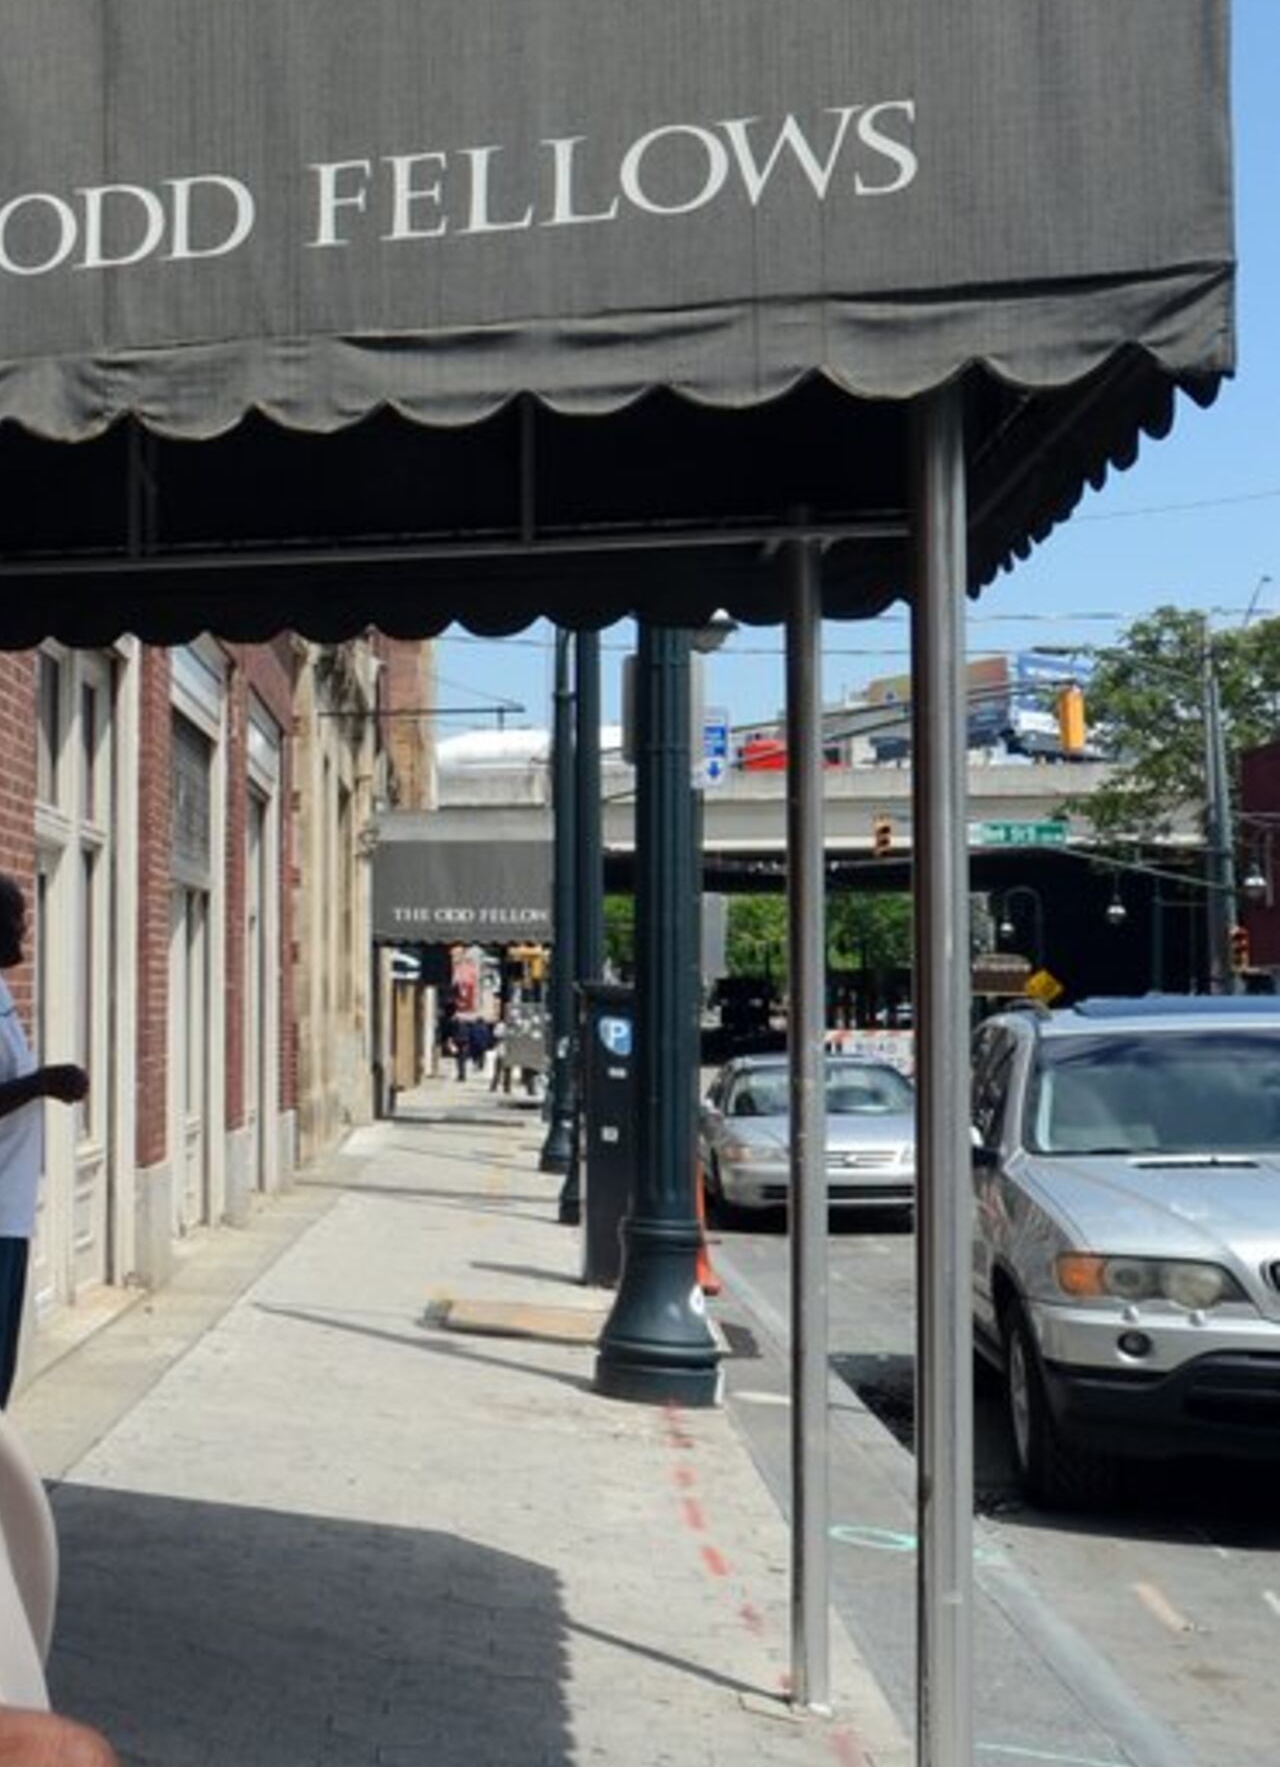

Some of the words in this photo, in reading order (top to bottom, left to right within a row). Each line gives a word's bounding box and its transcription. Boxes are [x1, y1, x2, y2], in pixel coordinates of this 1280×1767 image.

[305, 100, 919, 247] FELLOWS
[392, 908, 430, 922] THE
[434, 908, 475, 923] ODD
[478, 908, 548, 923] FELLOW
